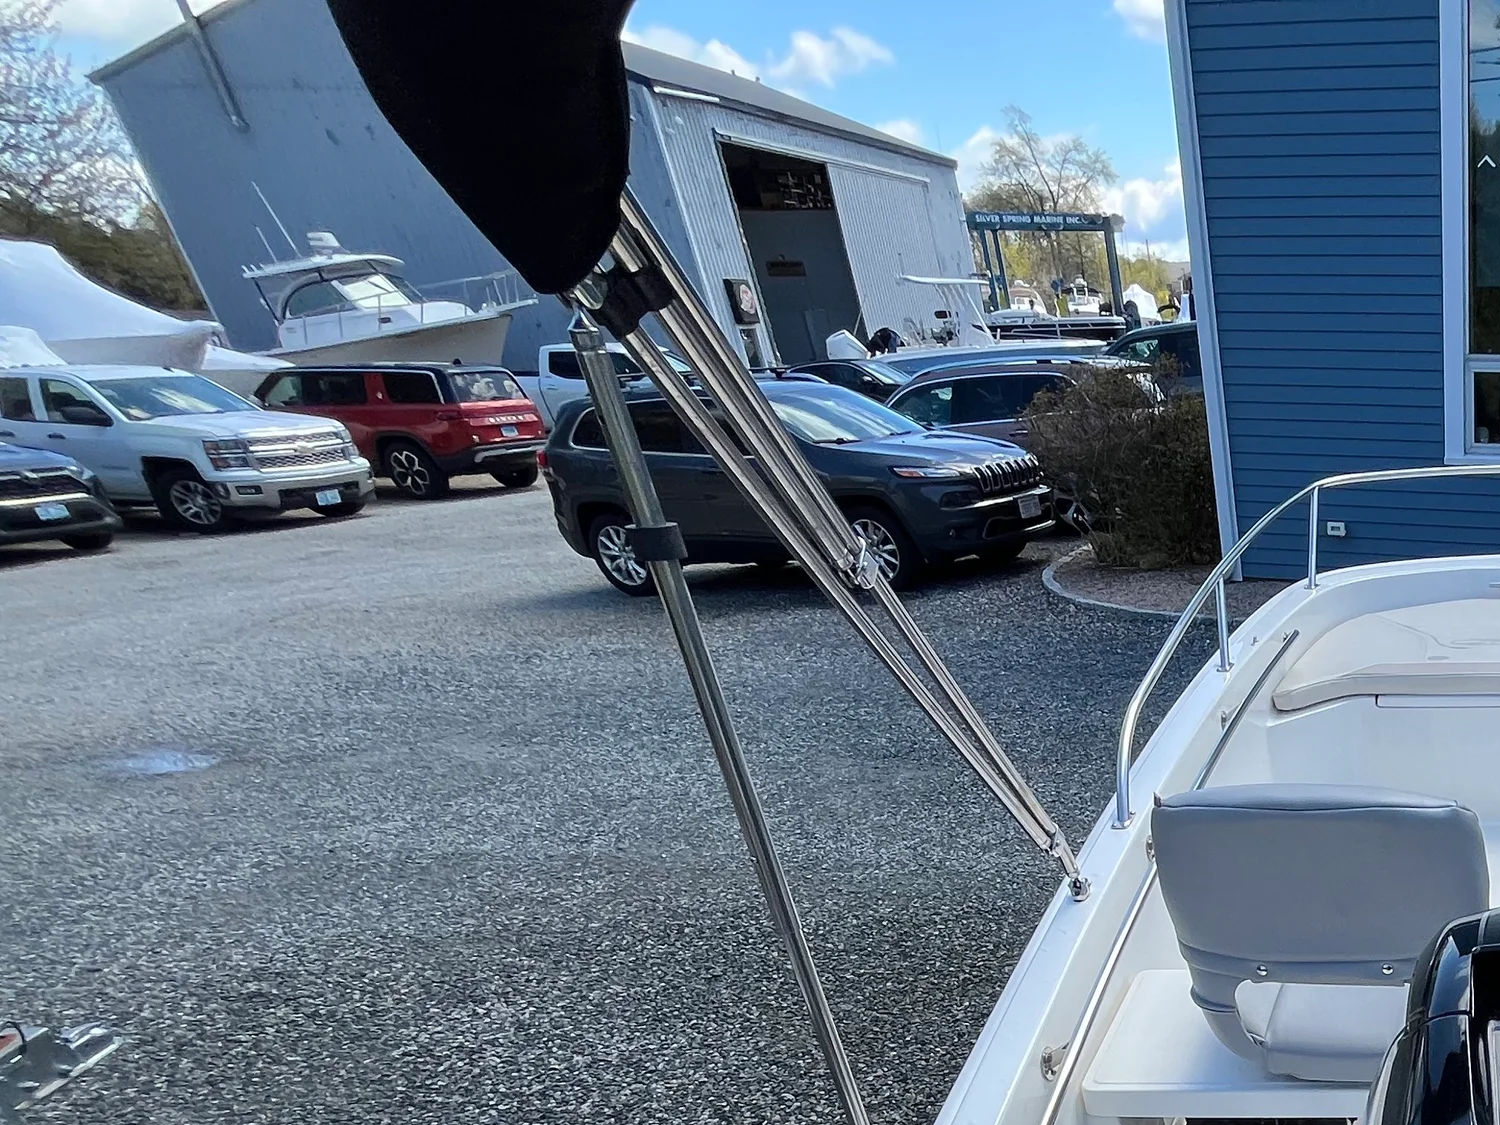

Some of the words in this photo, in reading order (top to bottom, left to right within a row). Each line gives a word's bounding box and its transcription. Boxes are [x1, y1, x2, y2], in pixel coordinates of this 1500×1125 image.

[975, 214, 1000, 223] SILVER
[1002, 215, 1032, 224] SPRING
[1033, 215, 1064, 224] MARINE
